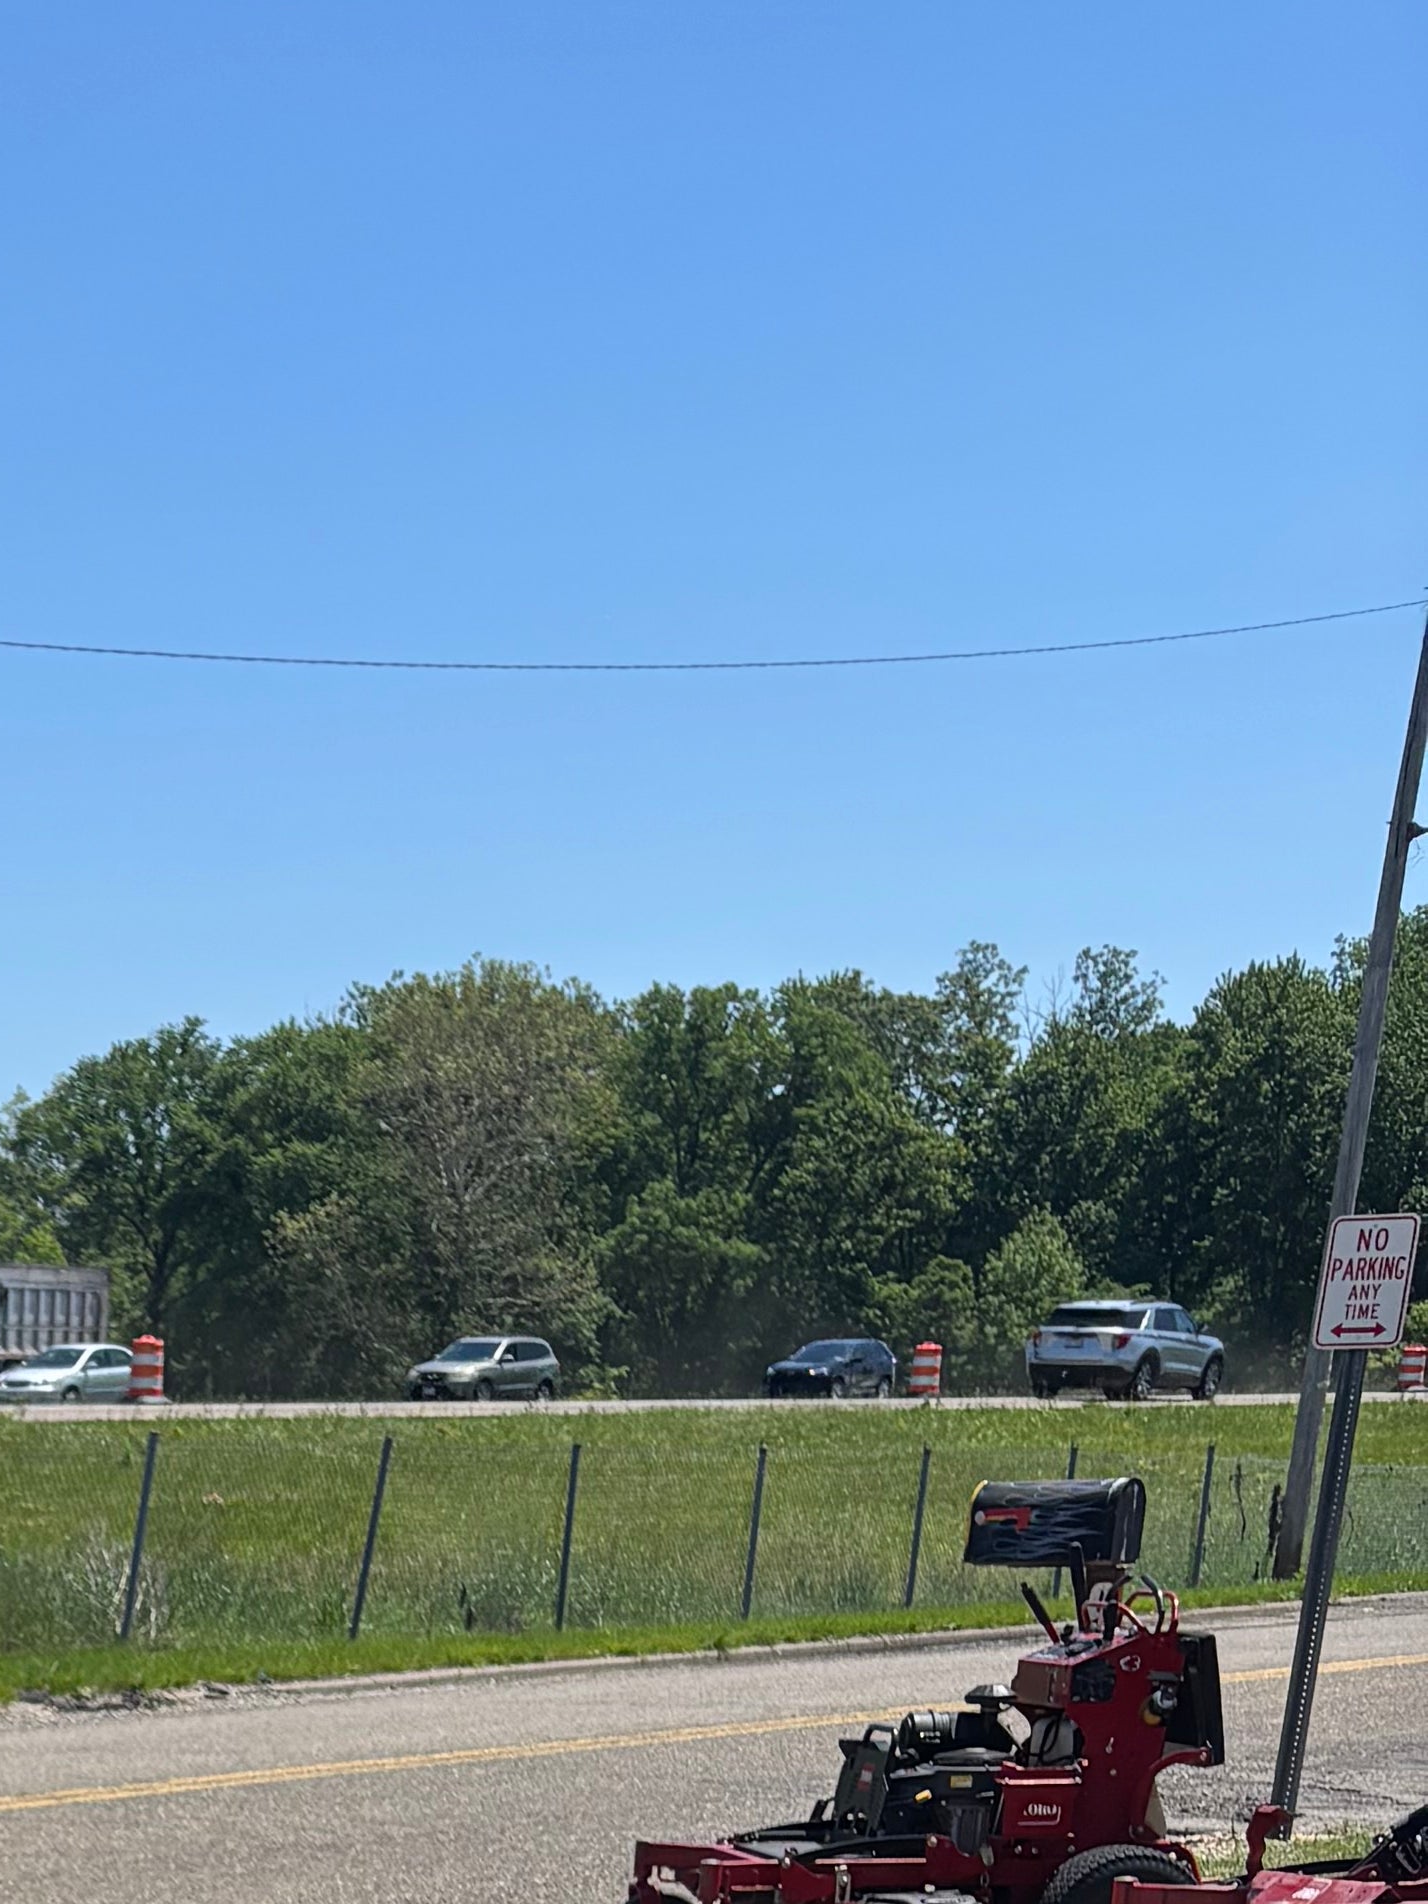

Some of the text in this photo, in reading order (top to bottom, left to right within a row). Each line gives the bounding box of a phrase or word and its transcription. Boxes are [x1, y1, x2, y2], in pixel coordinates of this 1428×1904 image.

[1357, 1228, 1389, 1252] NO
[1331, 1256, 1406, 1281] PARKING
[1348, 1284, 1382, 1301] ANY
[1345, 1304, 1380, 1320] TIME
